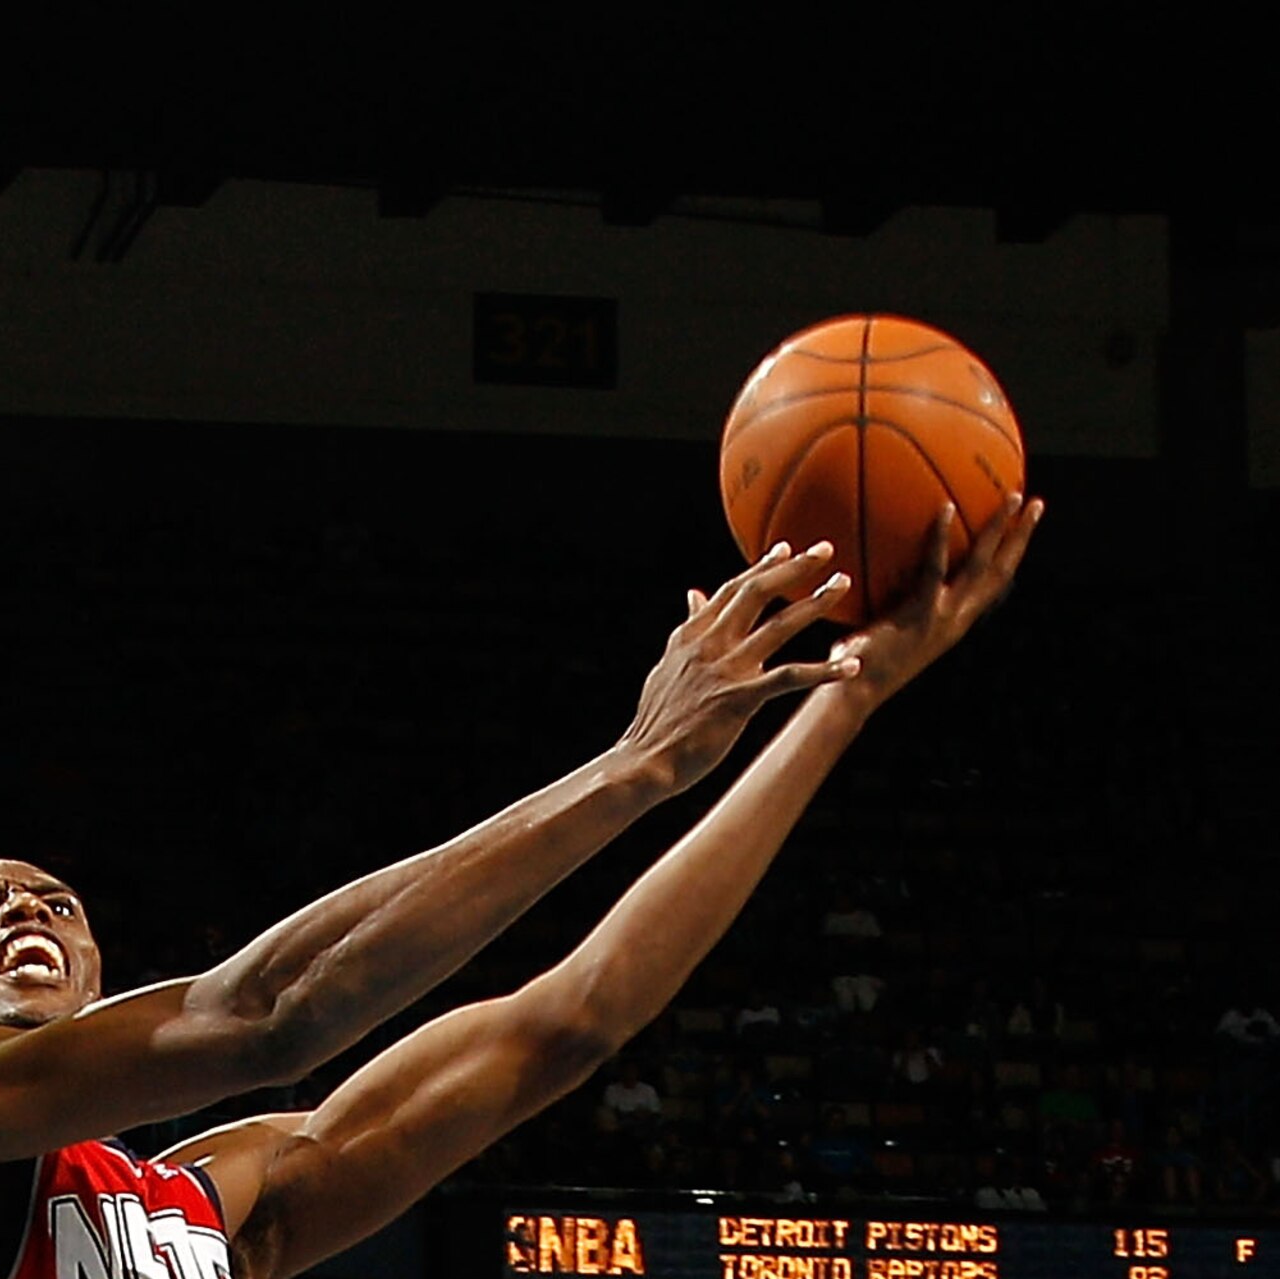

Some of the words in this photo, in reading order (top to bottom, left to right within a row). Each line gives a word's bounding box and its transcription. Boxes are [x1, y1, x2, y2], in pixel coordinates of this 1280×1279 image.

[489, 312, 600, 370] 321
[538, 1217, 646, 1276] NBA
[719, 1217, 850, 1250] DETROIT
[867, 1220, 999, 1254] PISTONS
[1113, 1228, 1170, 1258] 115
